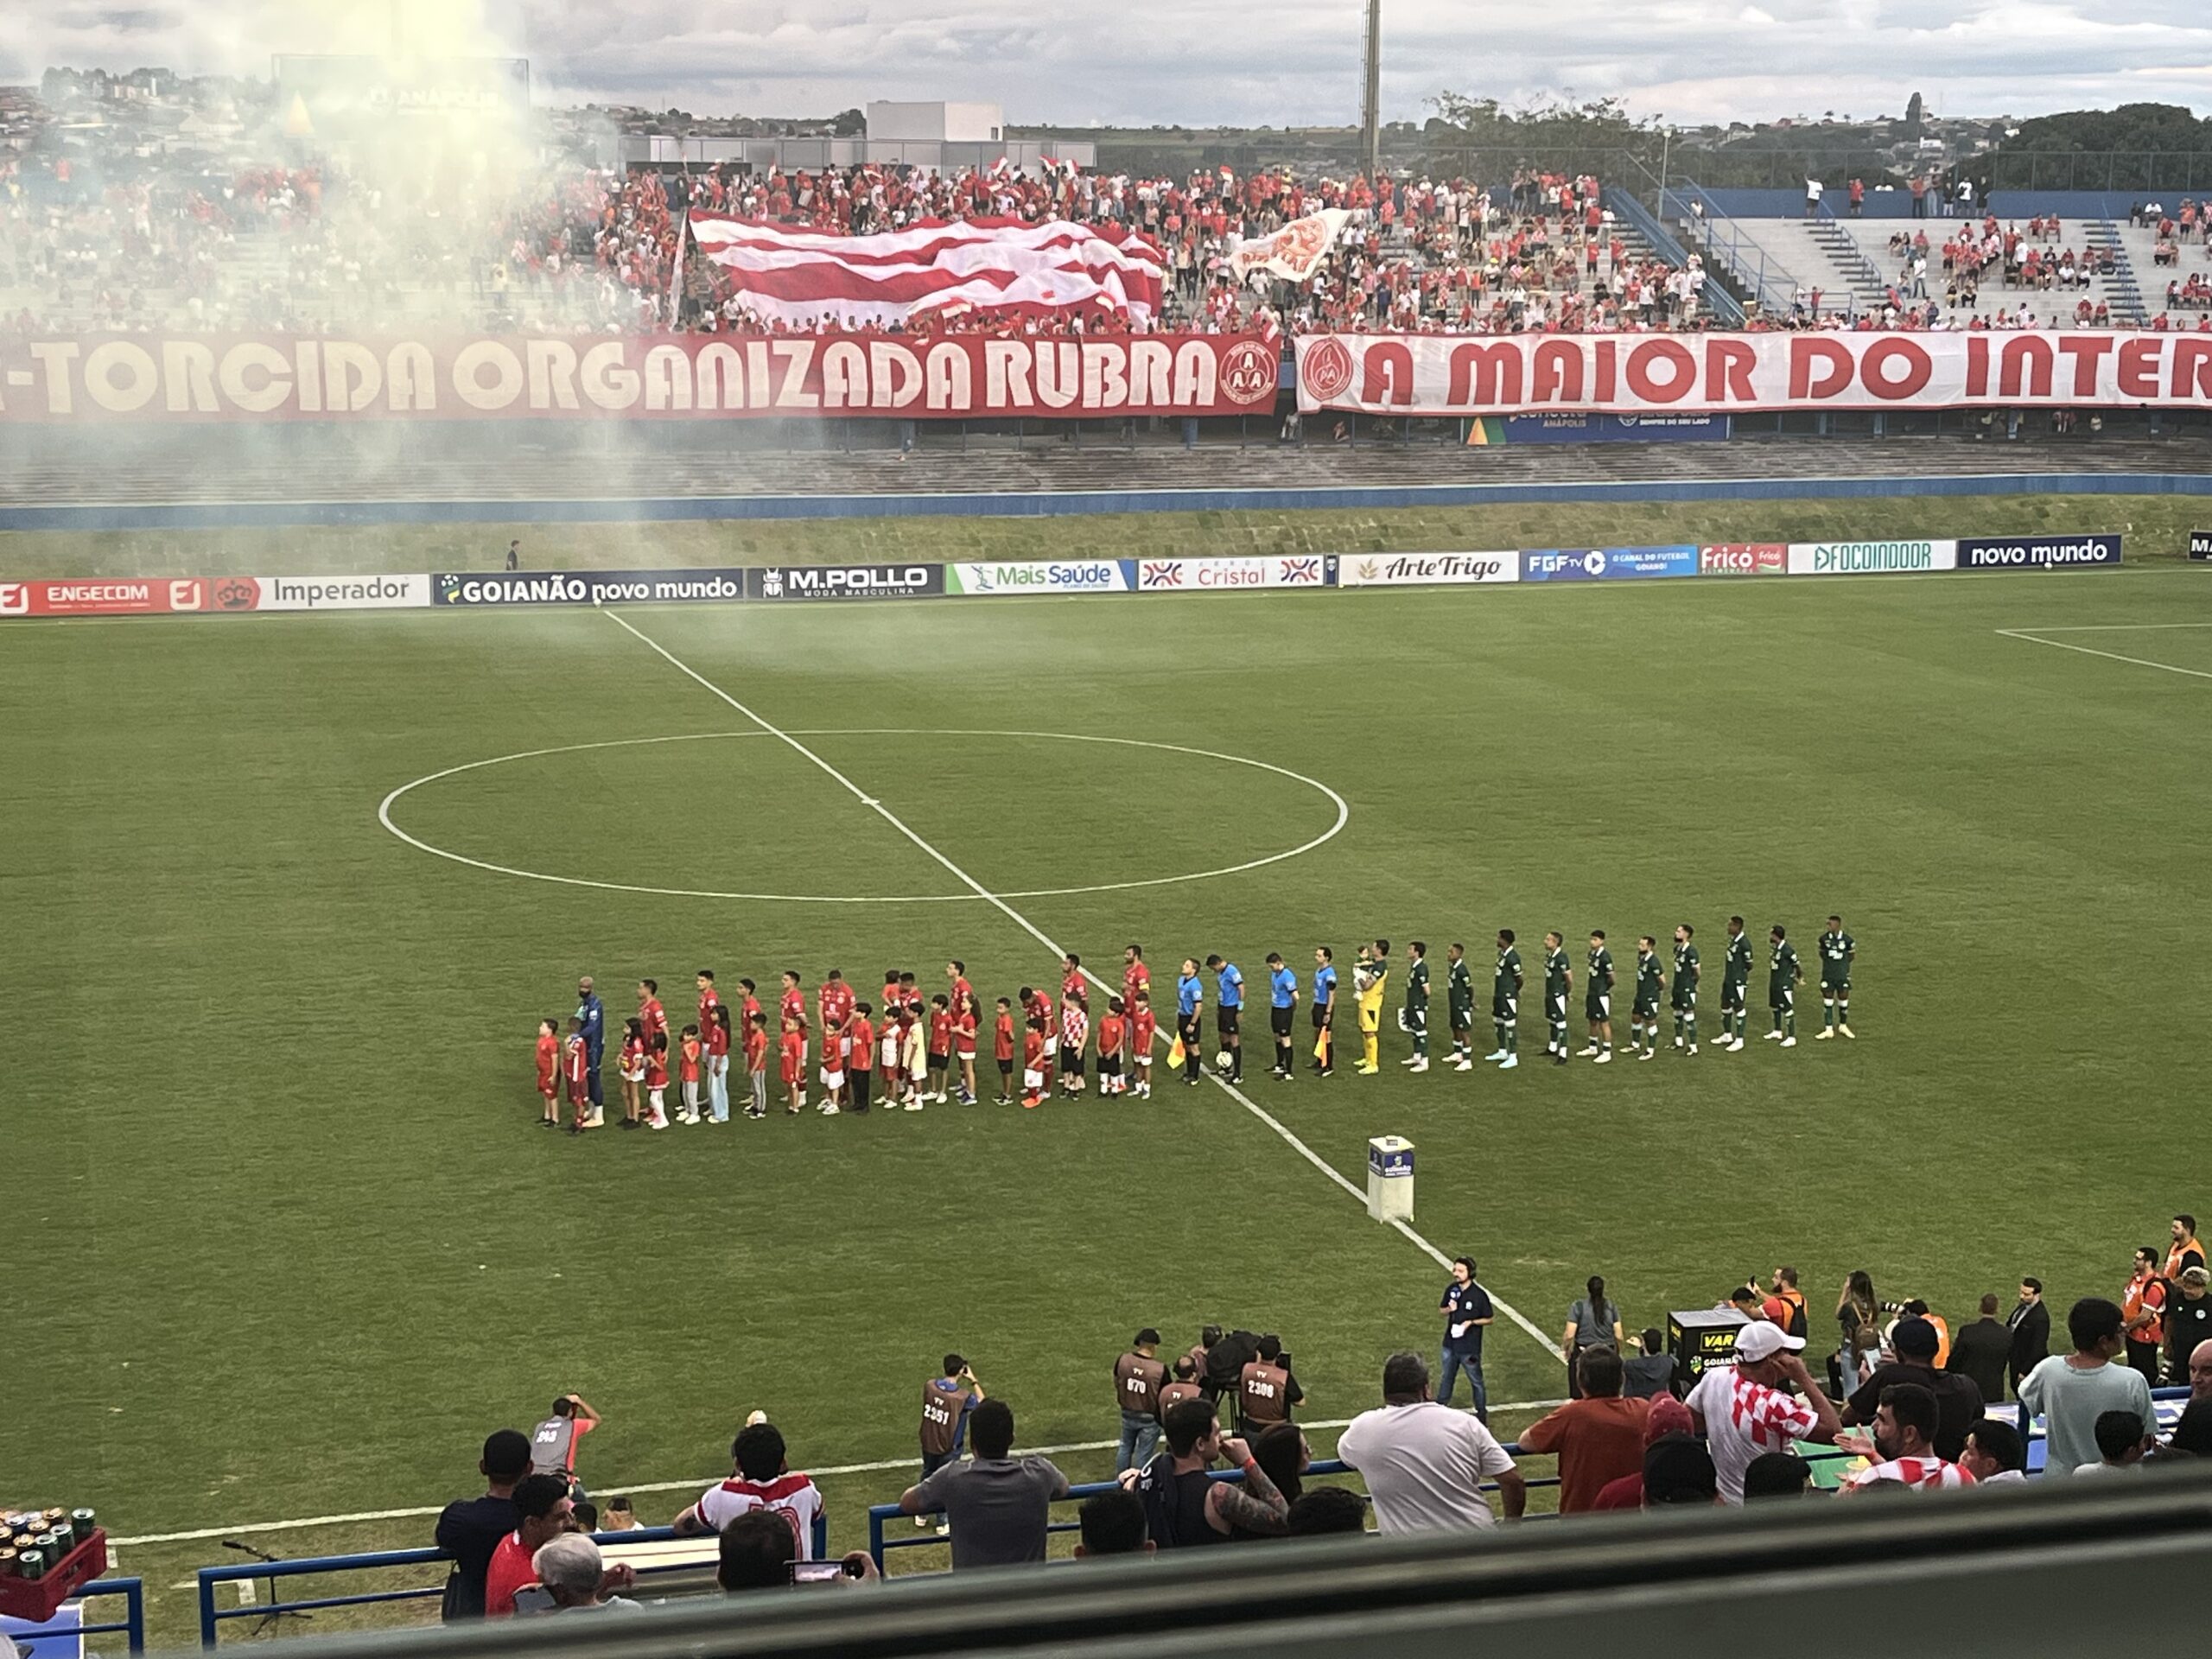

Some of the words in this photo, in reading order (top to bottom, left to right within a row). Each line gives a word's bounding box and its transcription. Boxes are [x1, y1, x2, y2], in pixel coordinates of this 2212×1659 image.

[452, 340, 970, 410] ORGANIZADA
[984, 340, 1217, 409] RUBRA
[1361, 341, 1414, 404] A
[1446, 339, 1758, 405] MAIOR
[1789, 337, 1932, 399] DO
[1966, 335, 2212, 397] INTER
[1972, 546, 2026, 564] novo
[2031, 539, 2107, 563] mundo
[789, 568, 928, 590] M.POLLO
[996, 565, 1046, 586] Mais
[1049, 564, 1111, 584] Saúde
[1198, 568, 1266, 586] Cristal
[48, 585, 149, 601] ENGECOM
[275, 577, 409, 607] Imperador
[462, 575, 587, 603] GOIANÃO
[592, 582, 649, 601] novo
[655, 576, 737, 598] mundo
[1704, 1334, 1734, 1348] VAR
